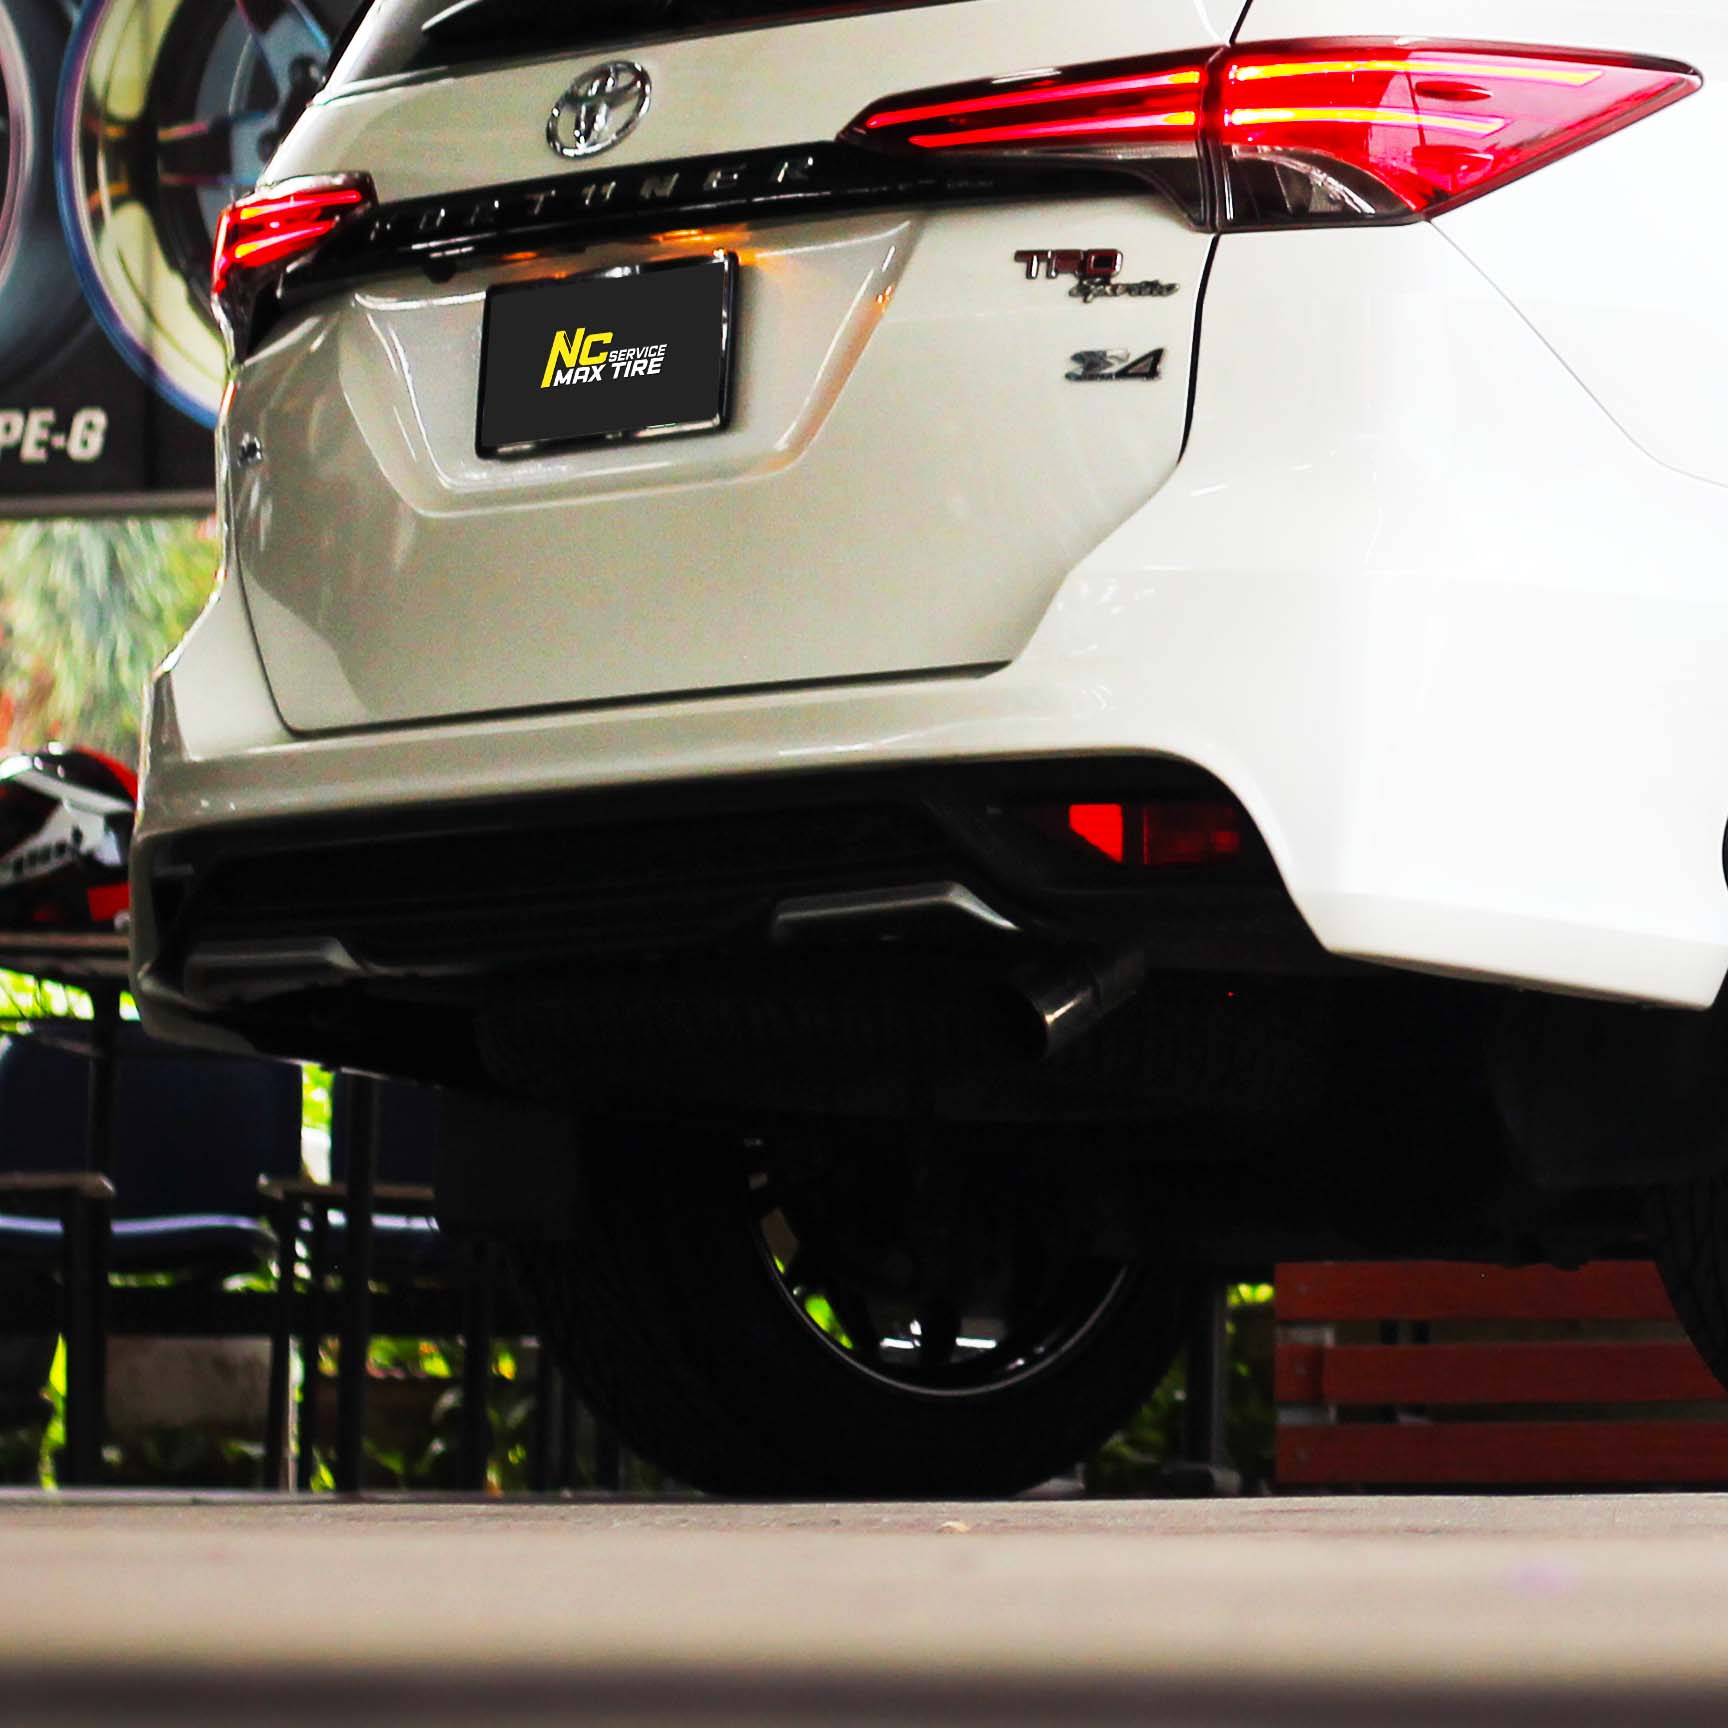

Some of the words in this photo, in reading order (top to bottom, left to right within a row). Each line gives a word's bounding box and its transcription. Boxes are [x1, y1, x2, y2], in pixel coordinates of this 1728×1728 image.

[541, 327, 614, 389] NC
[608, 343, 668, 363] SERVICE
[553, 364, 606, 387] MAX
[611, 357, 665, 379] TIRE
